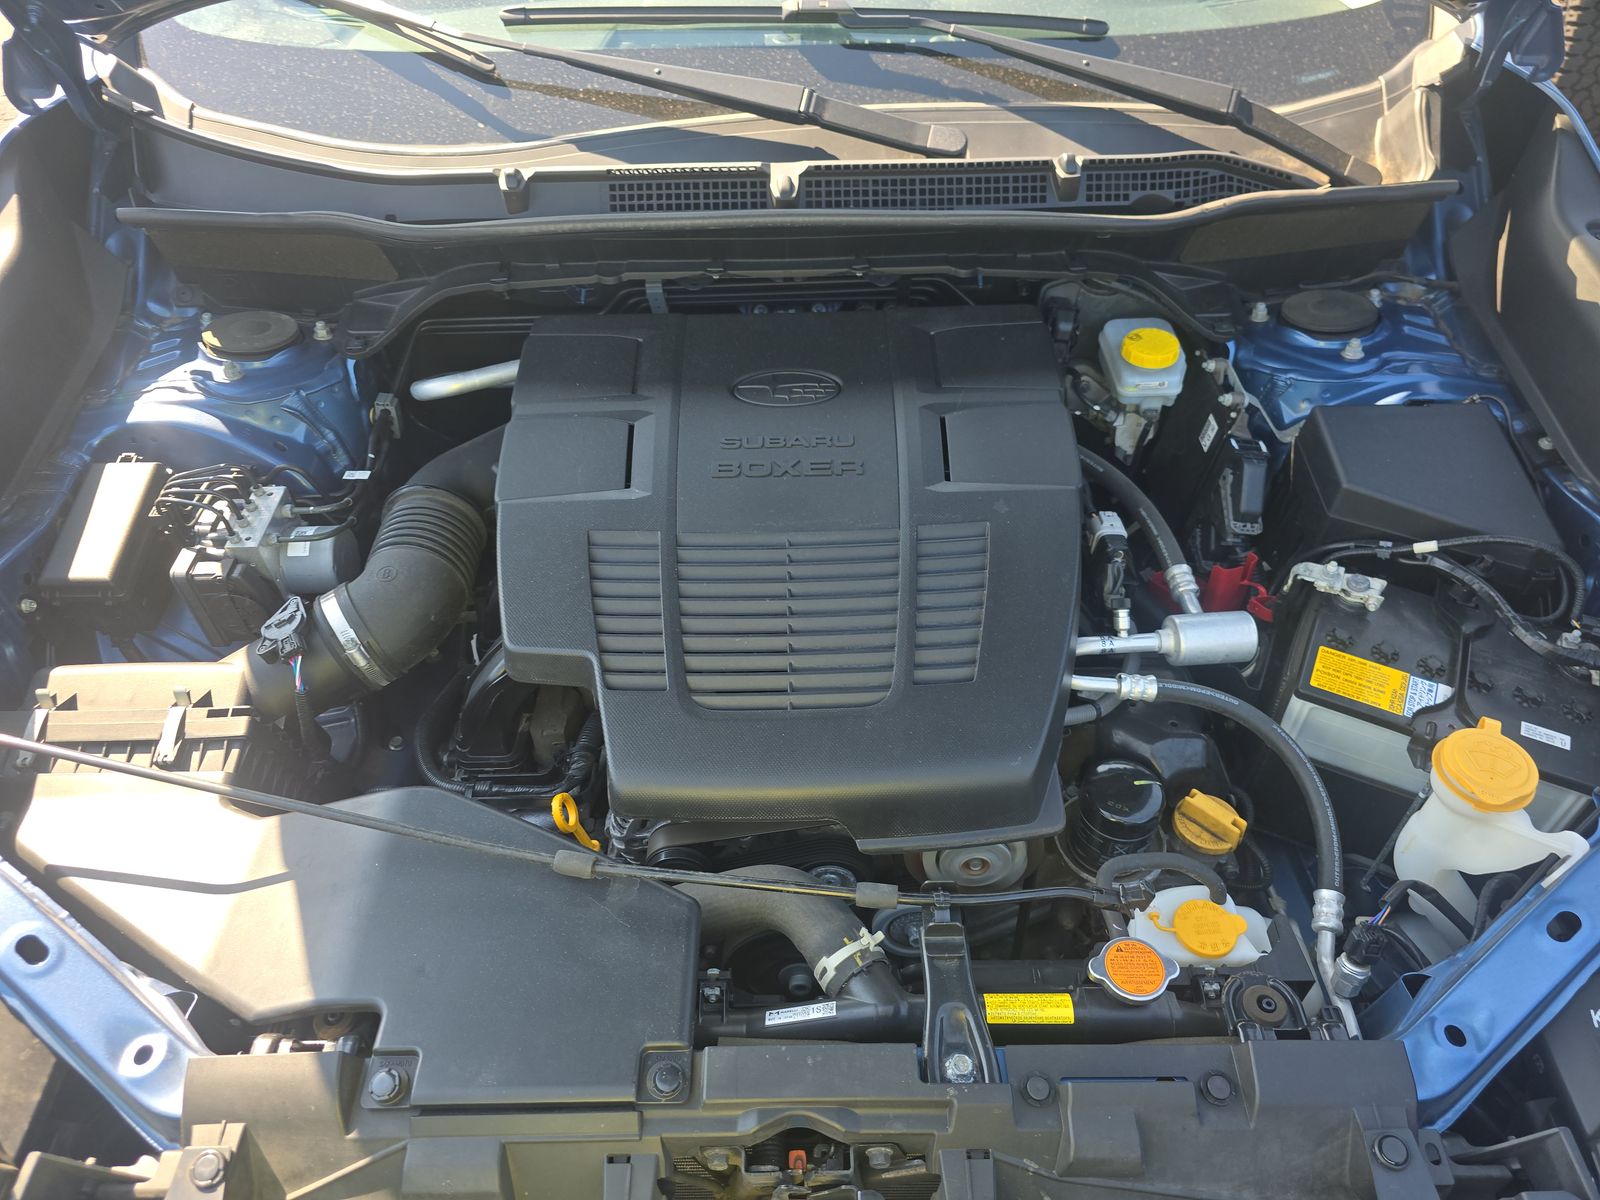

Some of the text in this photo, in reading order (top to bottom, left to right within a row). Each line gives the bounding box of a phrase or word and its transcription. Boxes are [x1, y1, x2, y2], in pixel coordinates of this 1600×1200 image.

[720, 433, 855, 450] SUBARU
[712, 459, 864, 478] BOXER
[1321, 648, 1347, 659] DANGER
